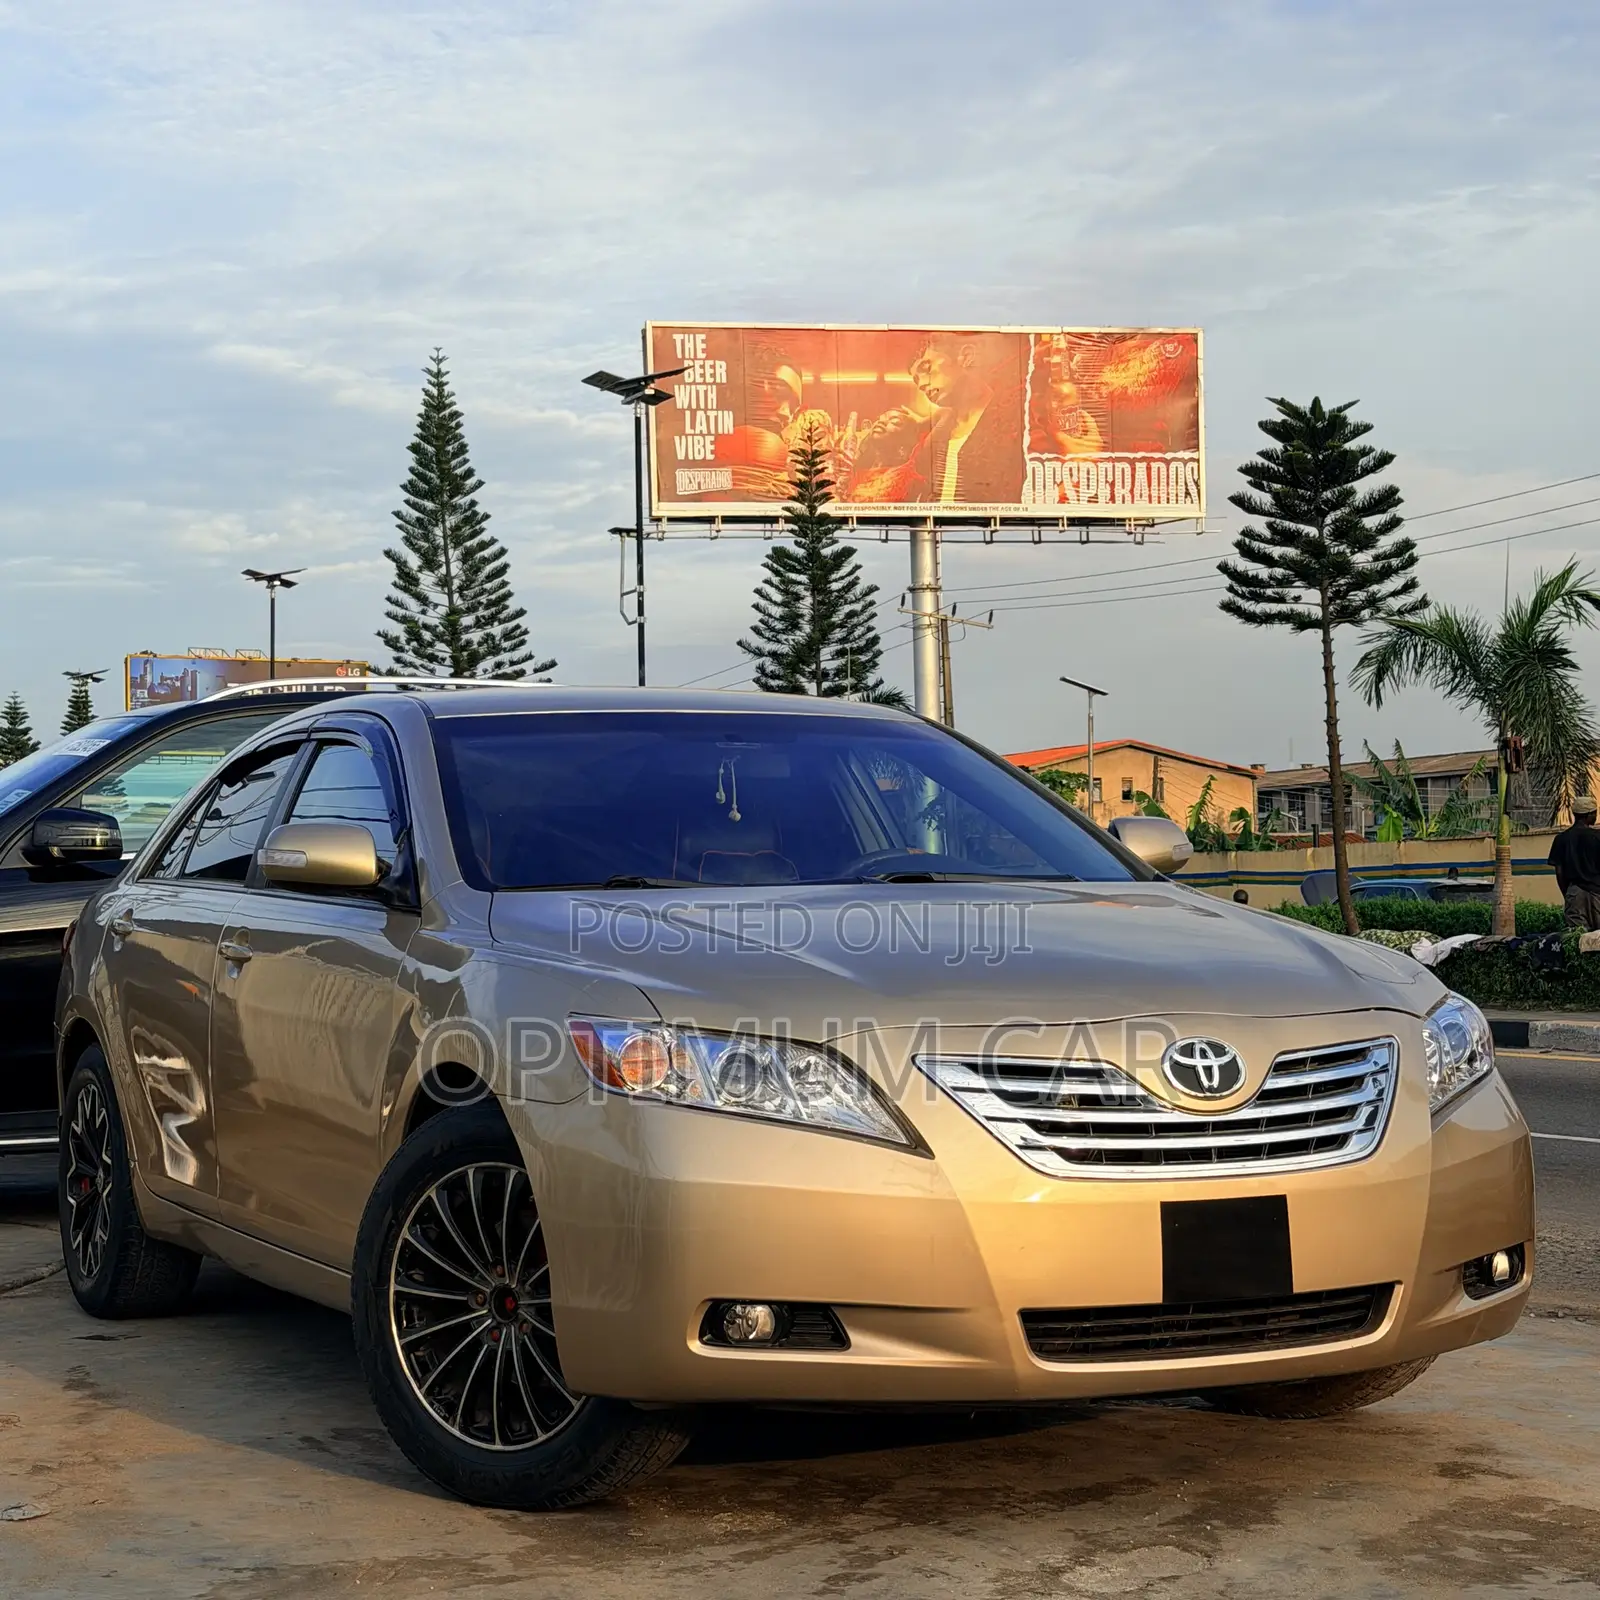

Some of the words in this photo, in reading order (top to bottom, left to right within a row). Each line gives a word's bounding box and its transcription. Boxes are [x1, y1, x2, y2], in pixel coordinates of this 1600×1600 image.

[672, 334, 707, 359] THE
[683, 360, 728, 384] BEER
[674, 385, 717, 409] WITH
[685, 411, 734, 434] LATIN
[674, 436, 715, 460] VIBE
[677, 469, 732, 494] DESPERADOS
[1023, 460, 1199, 504] DESPERADOS
[348, 668, 360, 676] LG
